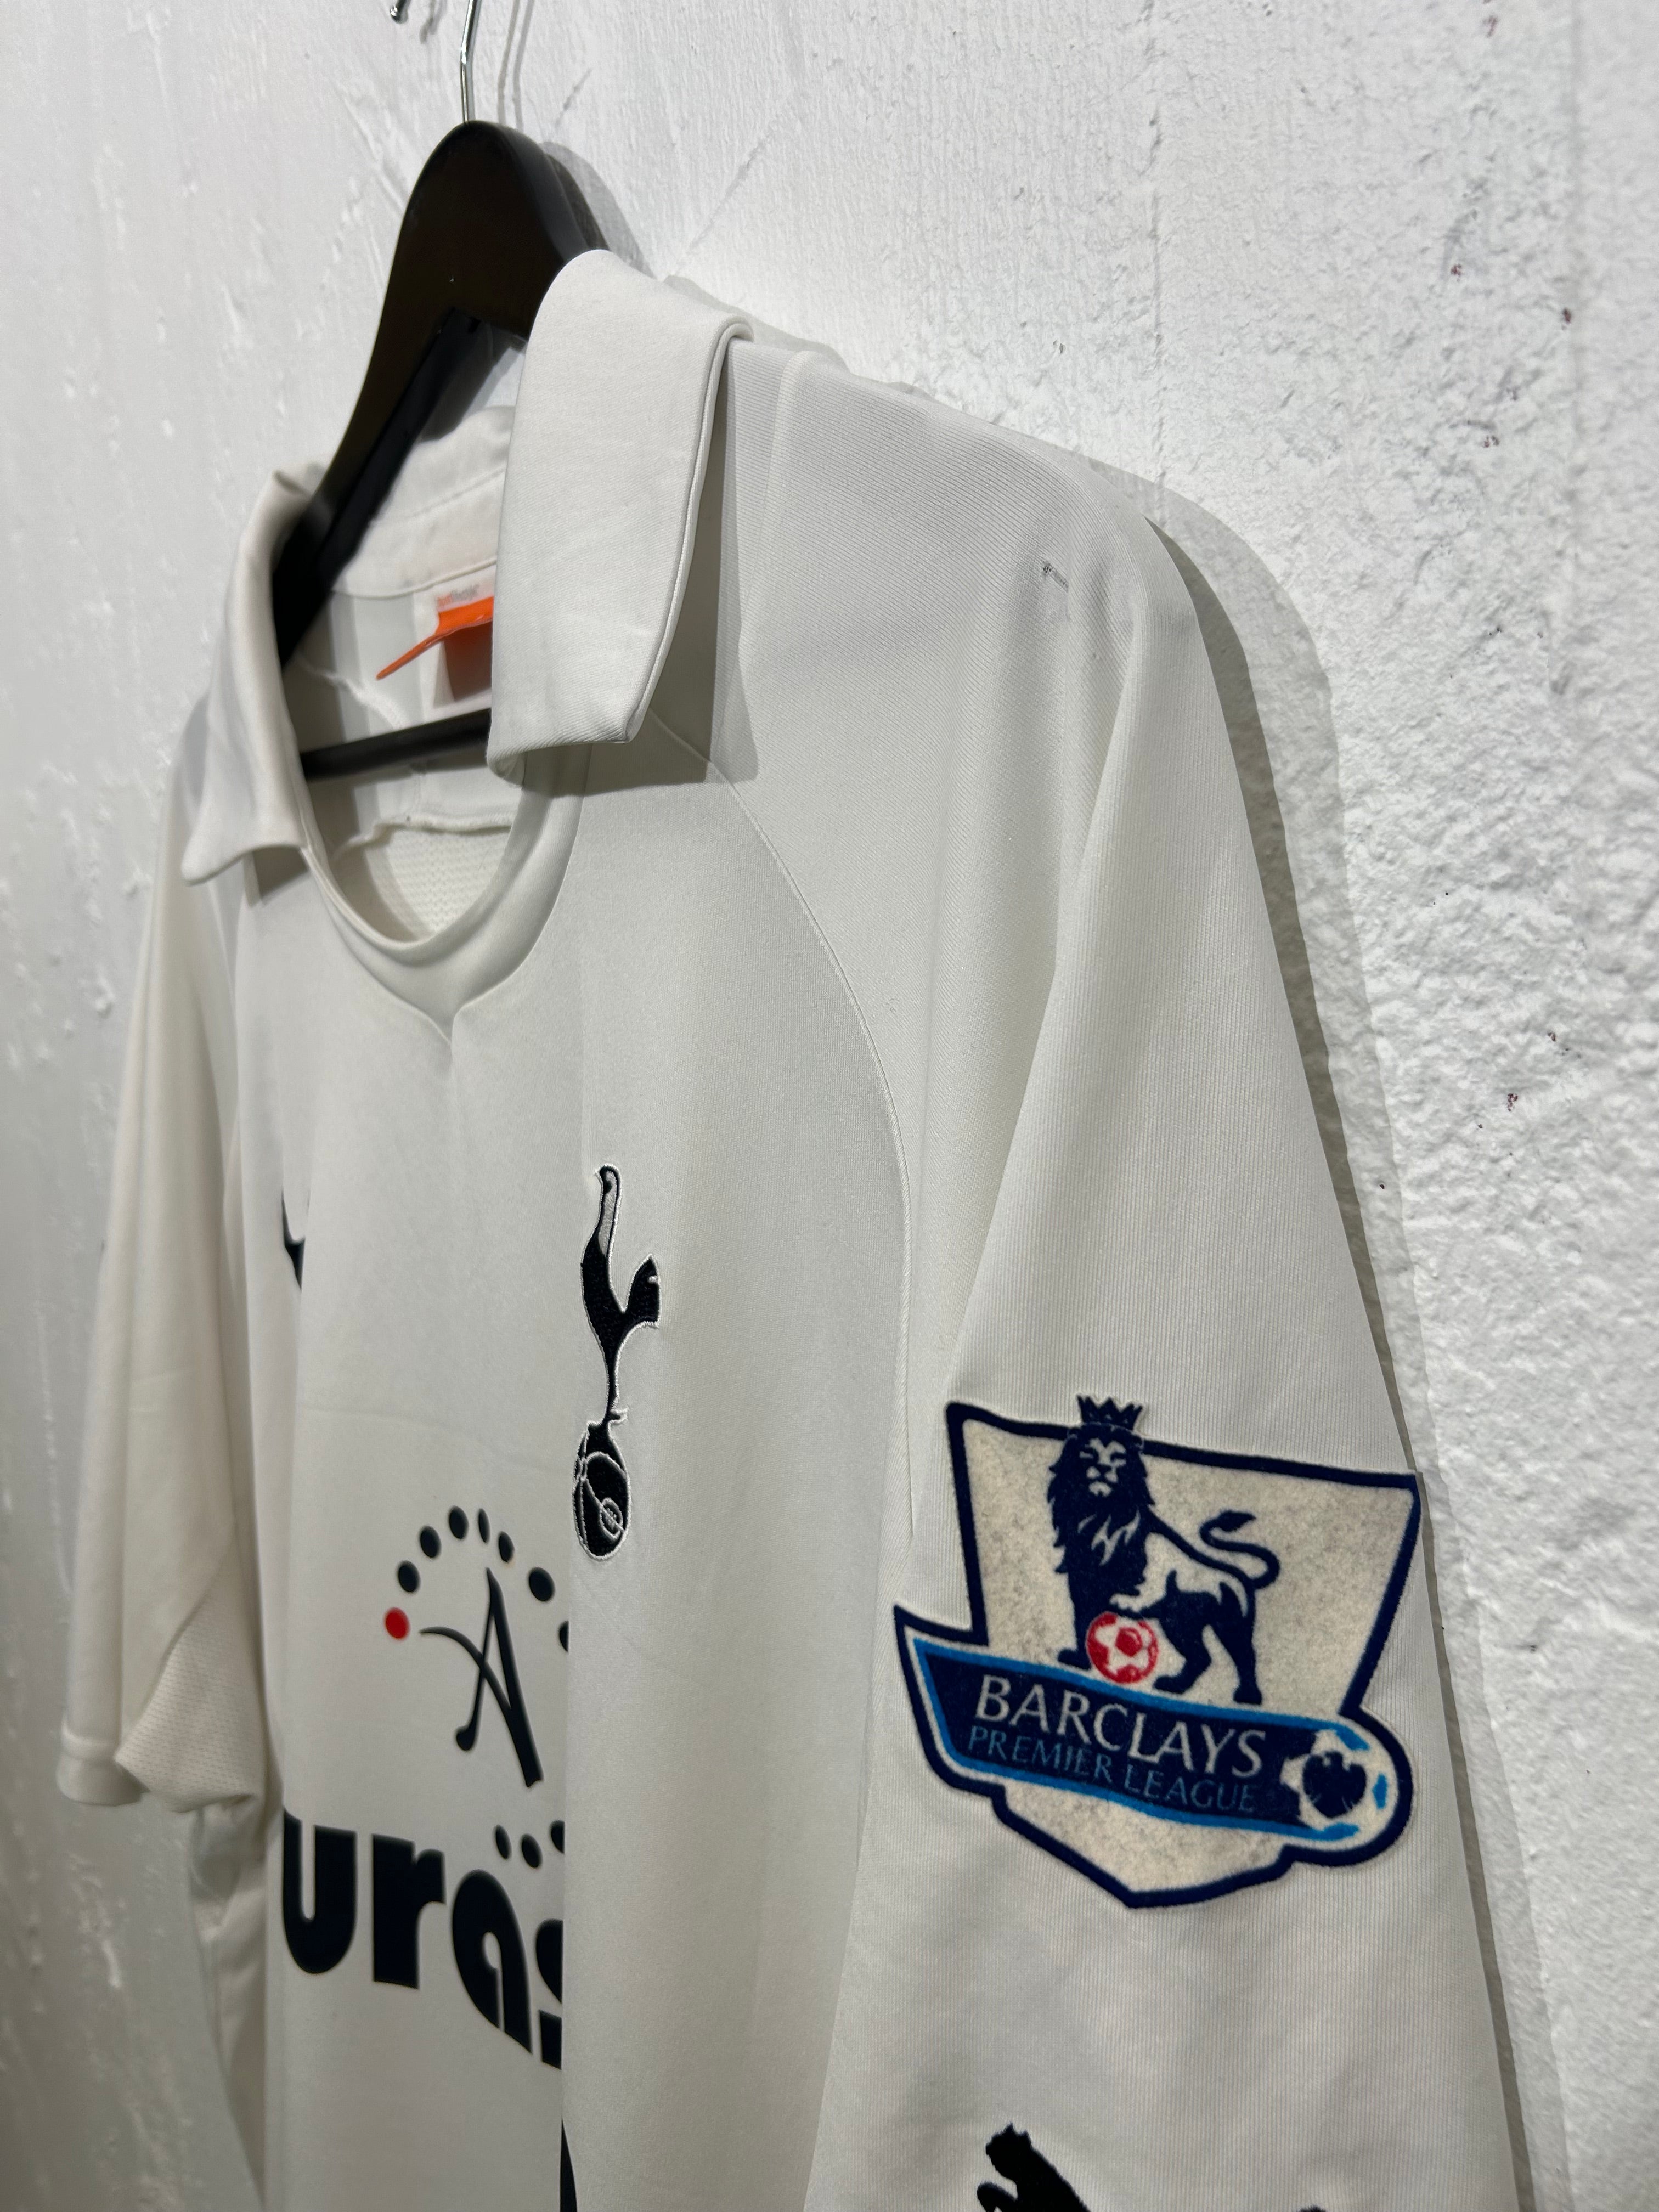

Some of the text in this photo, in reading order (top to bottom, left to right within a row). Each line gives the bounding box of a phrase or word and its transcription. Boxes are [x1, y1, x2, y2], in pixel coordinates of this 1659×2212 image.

[967, 1725, 1256, 1812] PREMIER LEAGUE
[975, 1674, 1266, 1778] BARCLAYS
